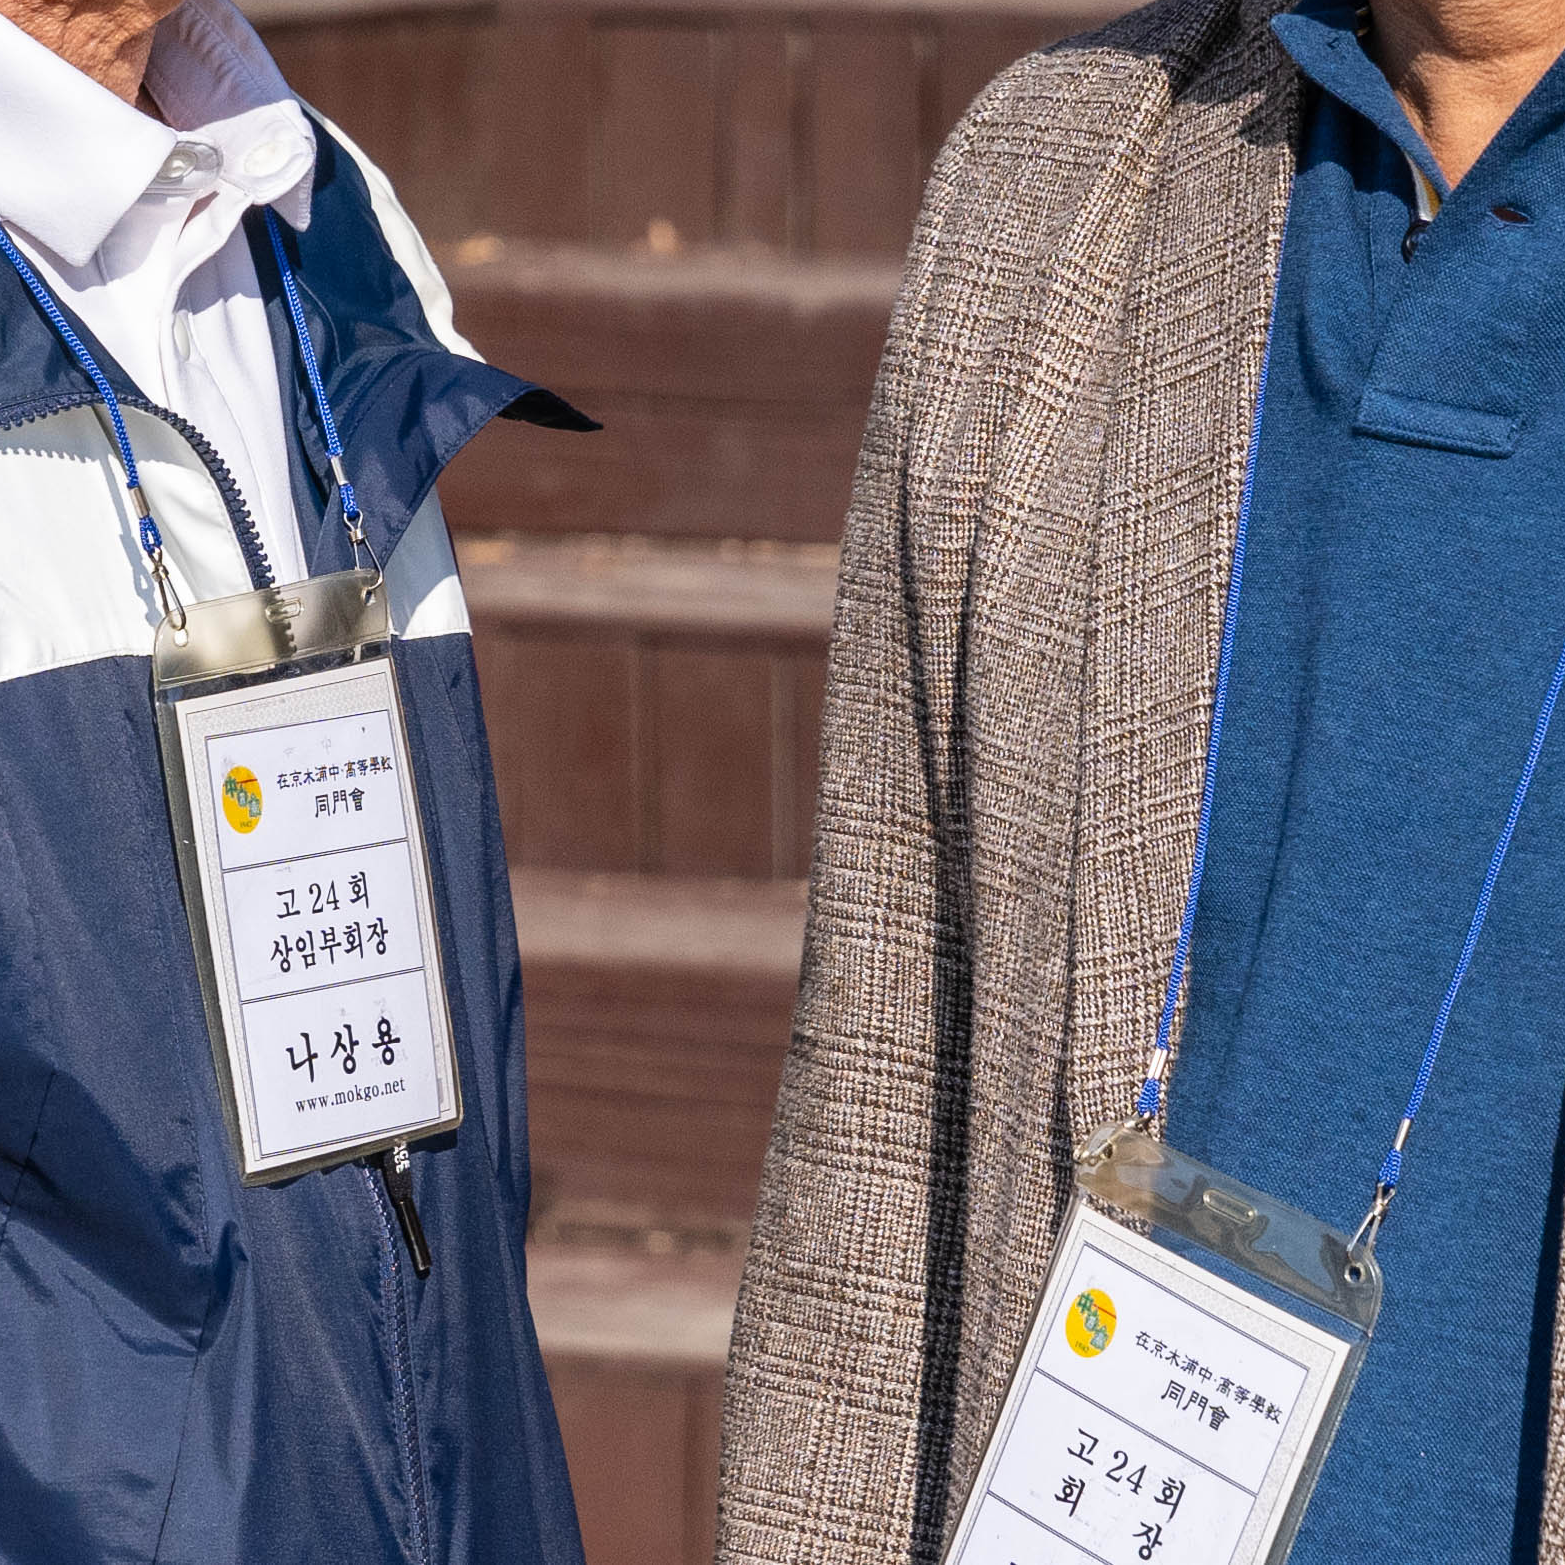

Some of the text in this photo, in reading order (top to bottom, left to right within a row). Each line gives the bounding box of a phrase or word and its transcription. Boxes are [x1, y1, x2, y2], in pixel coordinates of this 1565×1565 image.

[314, 787, 365, 818] 同門會
[308, 880, 340, 914] 24
[270, 917, 389, 973] 상임부회장
[295, 1078, 406, 1112] www.mokgo.net
[1160, 1379, 1231, 1431] 同門會
[1105, 1450, 1147, 1495] 24
